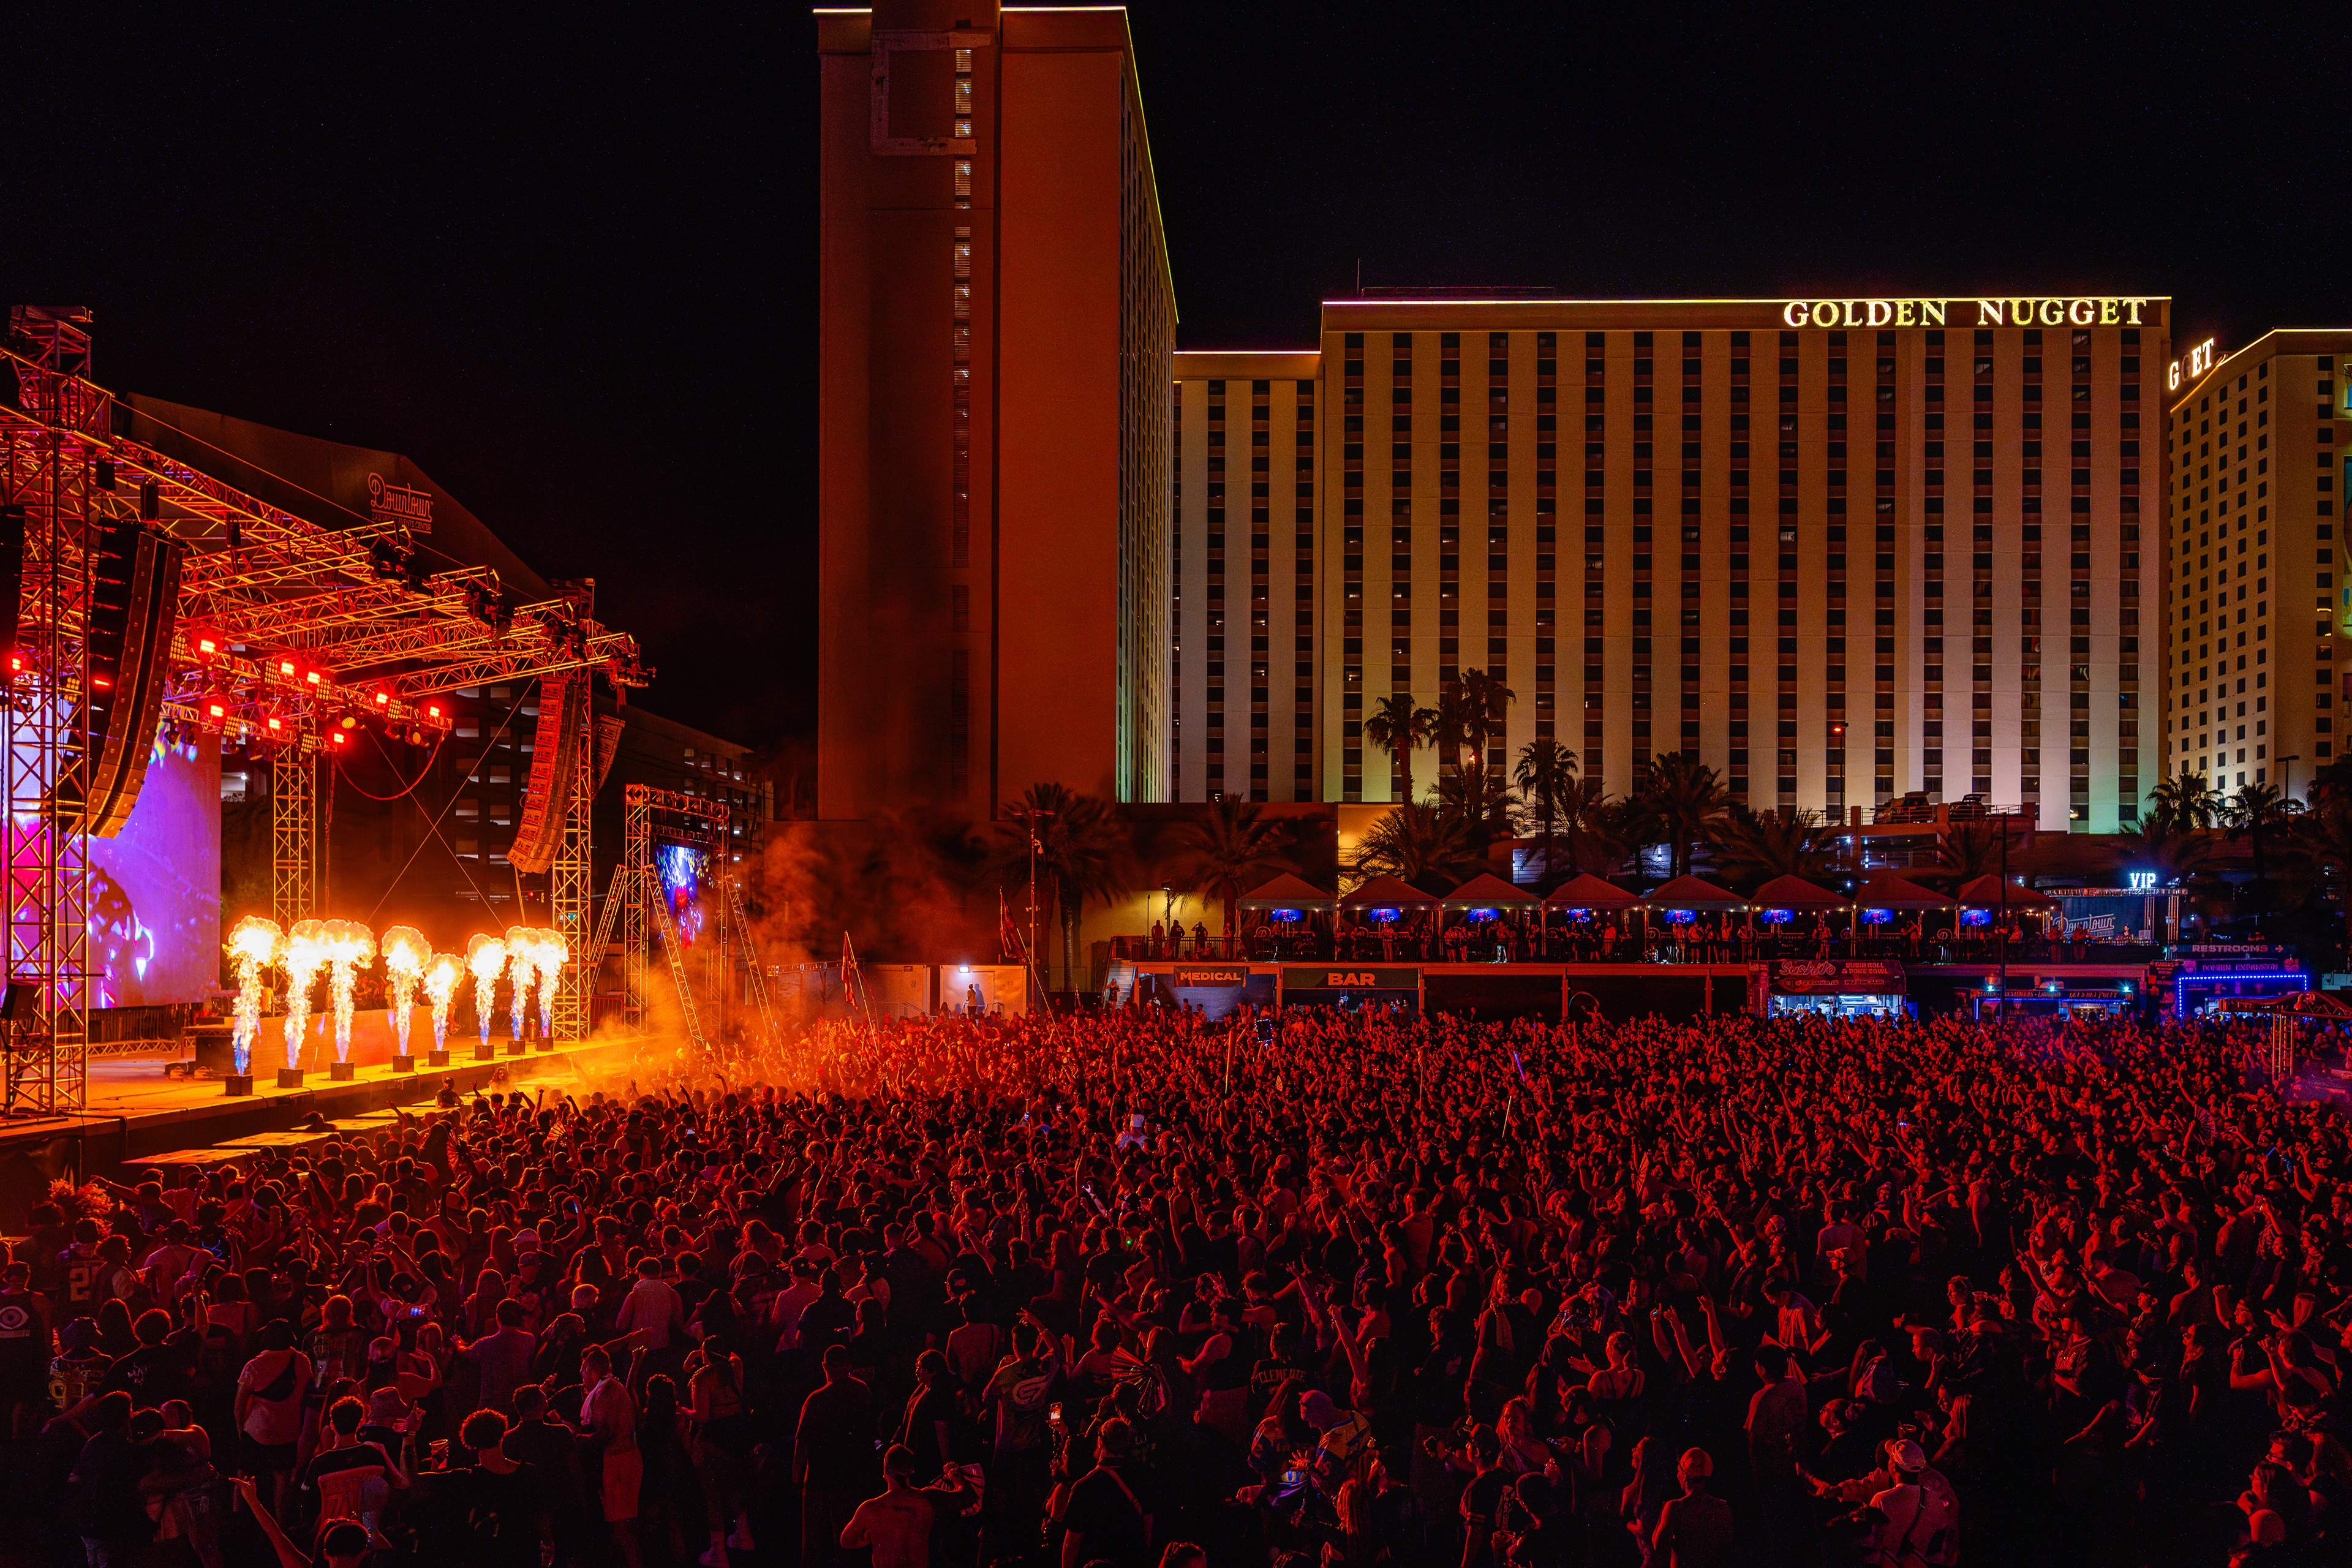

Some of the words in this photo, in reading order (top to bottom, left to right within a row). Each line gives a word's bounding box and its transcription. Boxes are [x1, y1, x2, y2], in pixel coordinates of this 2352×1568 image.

[1784, 301, 1948, 327] GOLDEN
[1977, 298, 2147, 326] NUGGET
[368, 472, 432, 522] Downtown
[372, 513, 381, 521] LAS
[415, 521, 431, 531] CENTER
[2130, 873, 2157, 888] VIP
[1180, 971, 1242, 981] MEDICAL
[1328, 973, 1376, 986] BAR
